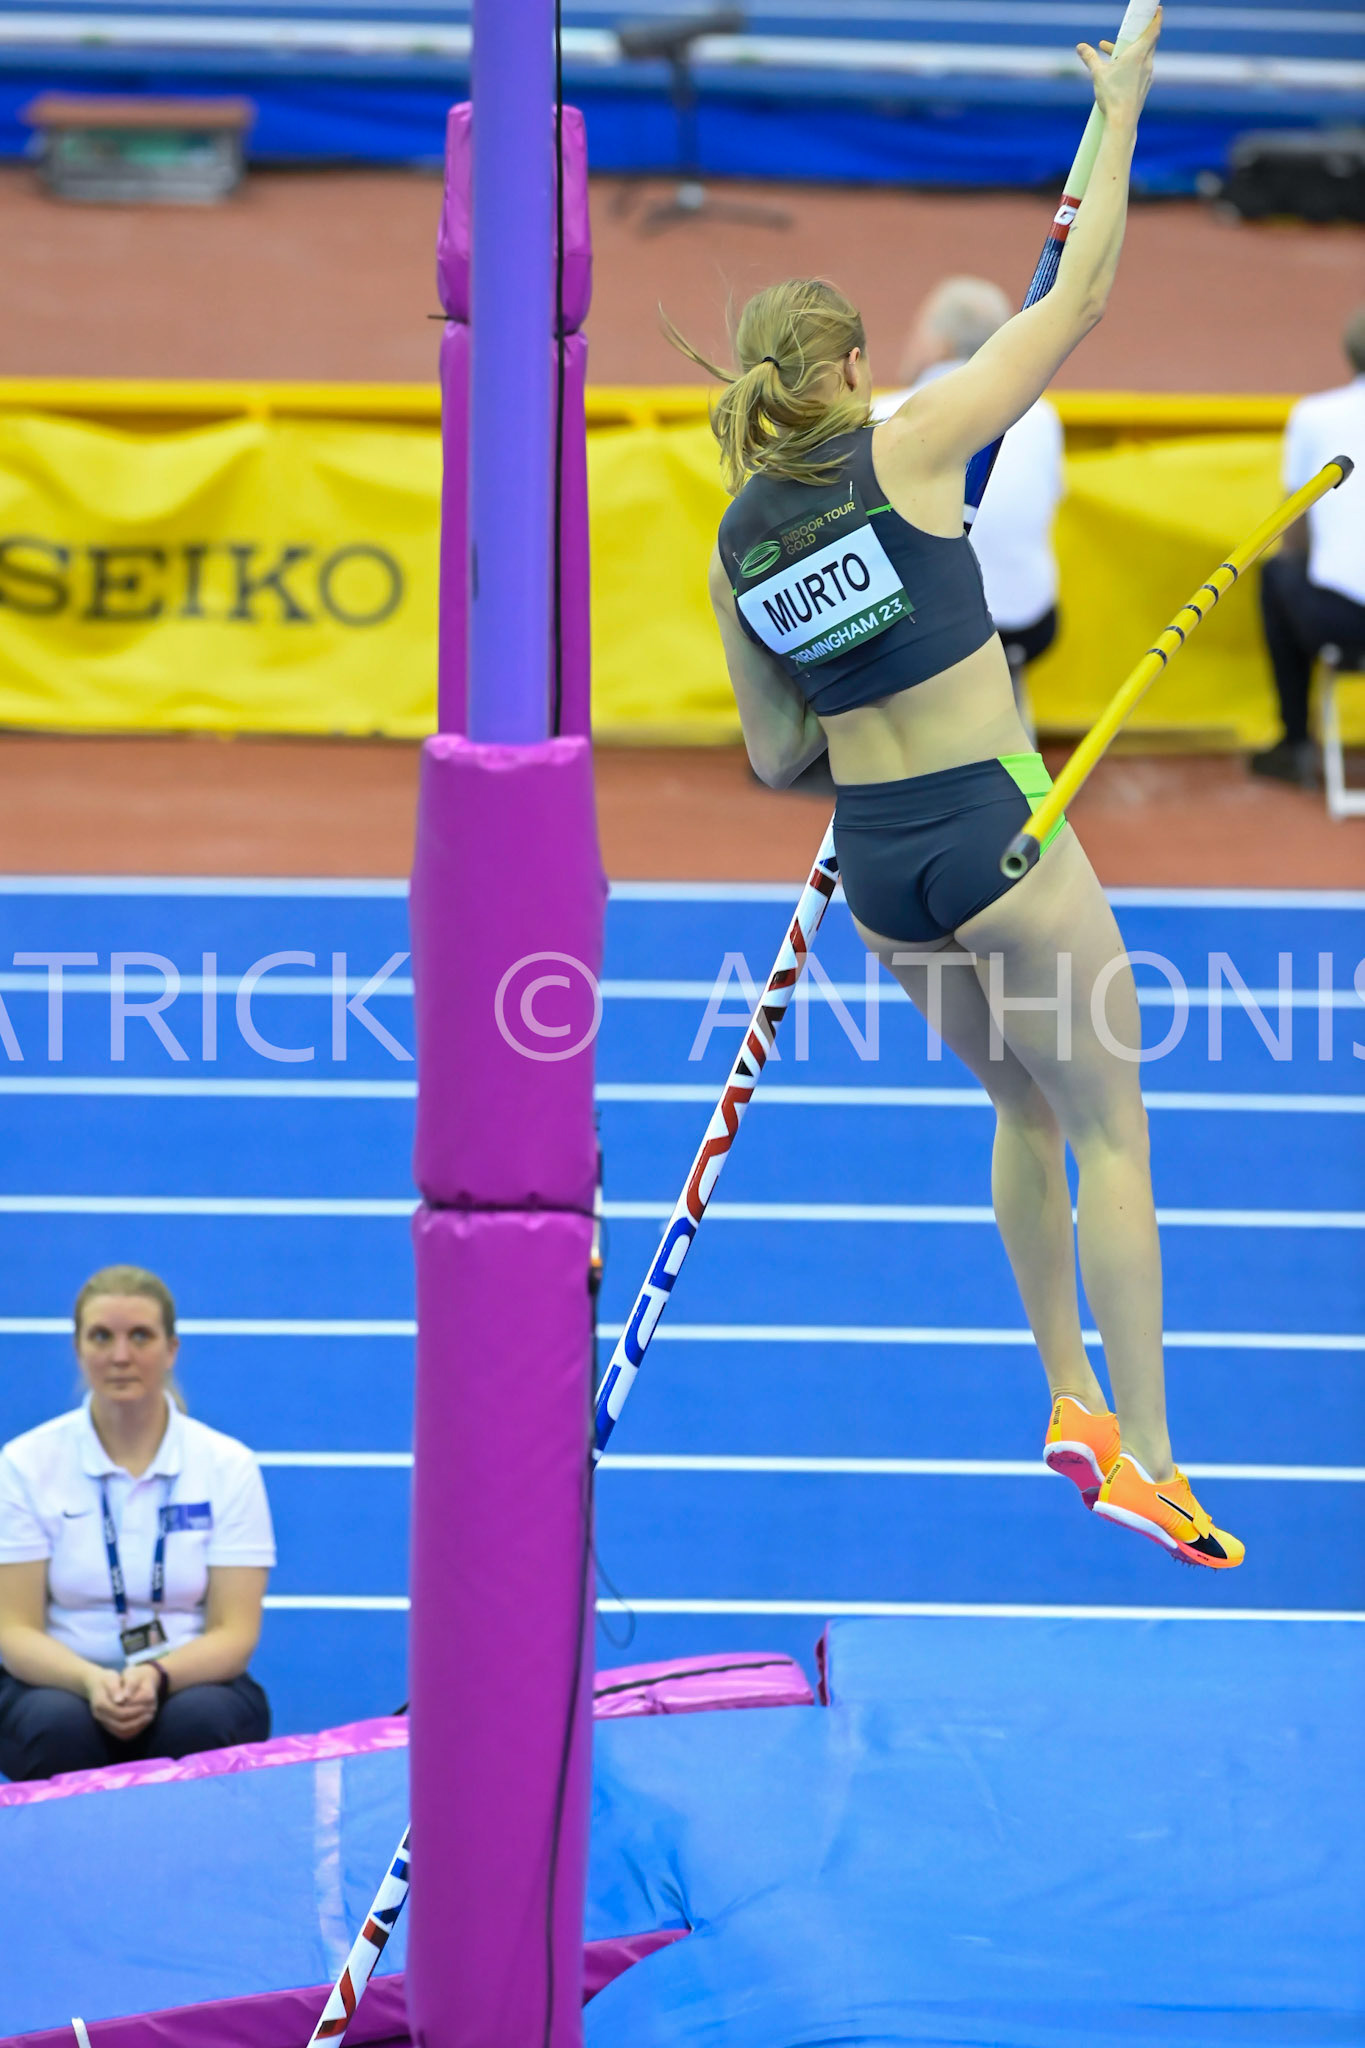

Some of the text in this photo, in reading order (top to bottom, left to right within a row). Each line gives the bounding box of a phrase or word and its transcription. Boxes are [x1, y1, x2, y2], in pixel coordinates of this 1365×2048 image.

[782, 517, 825, 547] INDOOR
[823, 501, 856, 523] TOUR
[786, 533, 816, 555] GOLD
[0, 535, 404, 628] SEIKO
[762, 552, 871, 636] MURTO
[878, 597, 903, 622] 23
